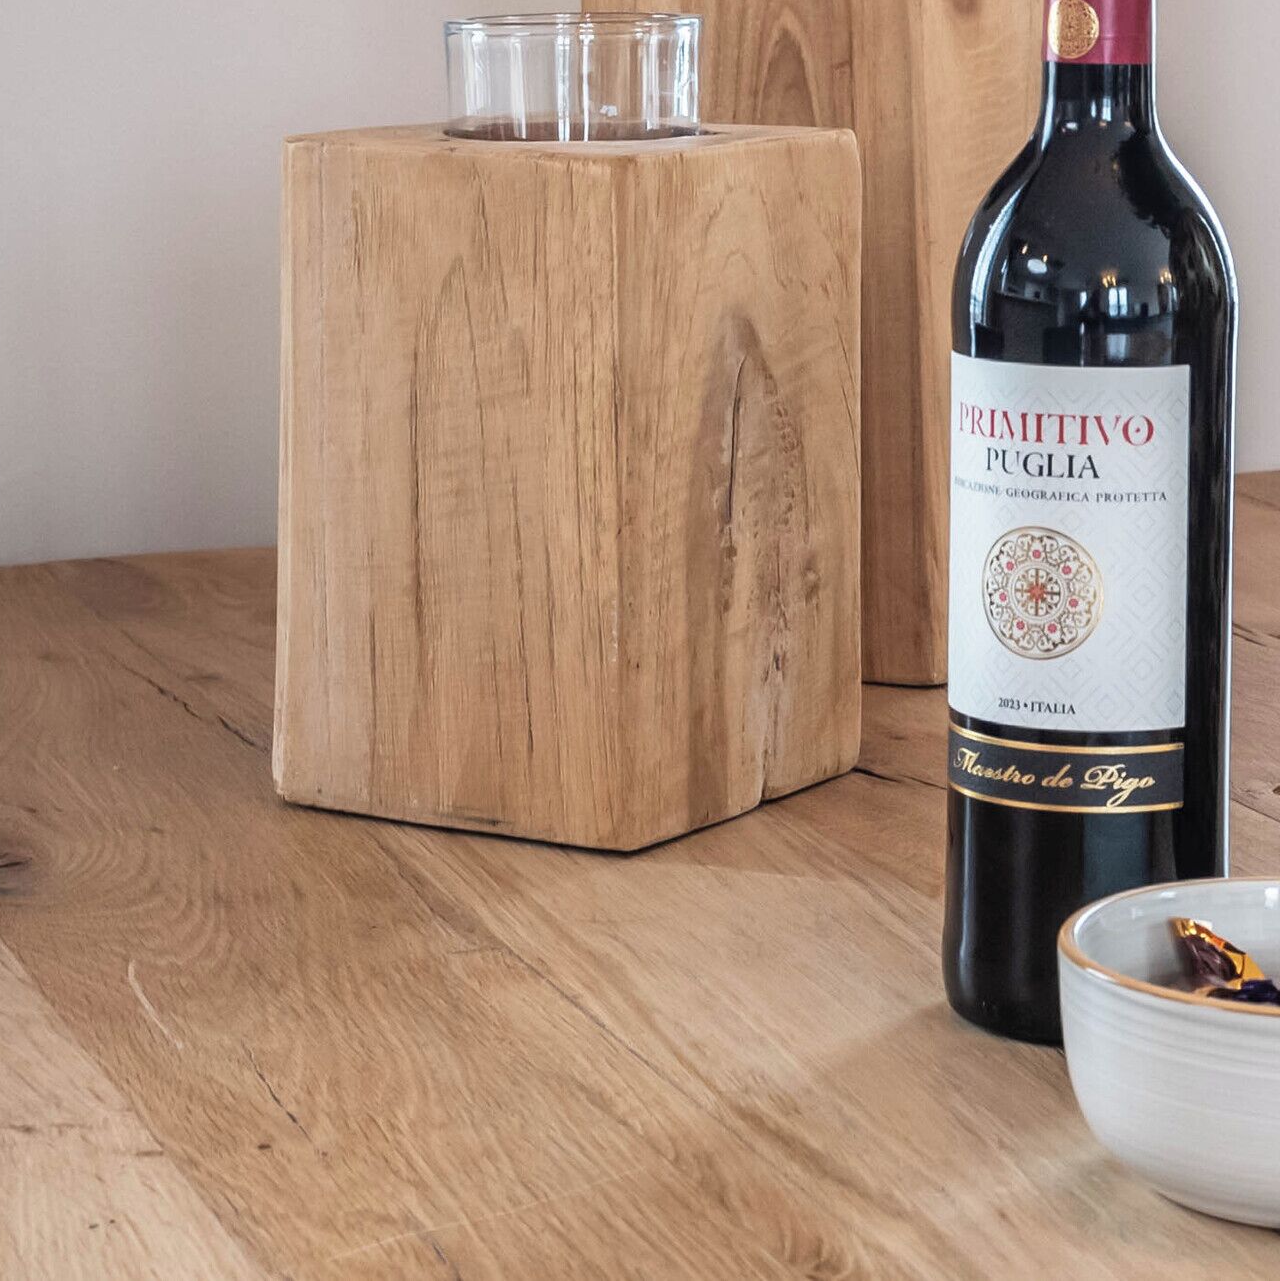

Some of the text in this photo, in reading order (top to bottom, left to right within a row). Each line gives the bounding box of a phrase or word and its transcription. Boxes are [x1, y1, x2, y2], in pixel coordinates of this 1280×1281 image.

[959, 401, 1155, 446] PRIMITIVO
[986, 447, 1101, 479] PUGLIA
[1006, 487, 1090, 503] GEOGRAFICA
[1096, 491, 1168, 504] PROTETTA
[1031, 700, 1076, 715] ITALIA
[953, 747, 1156, 808] Maestro de Pigo
